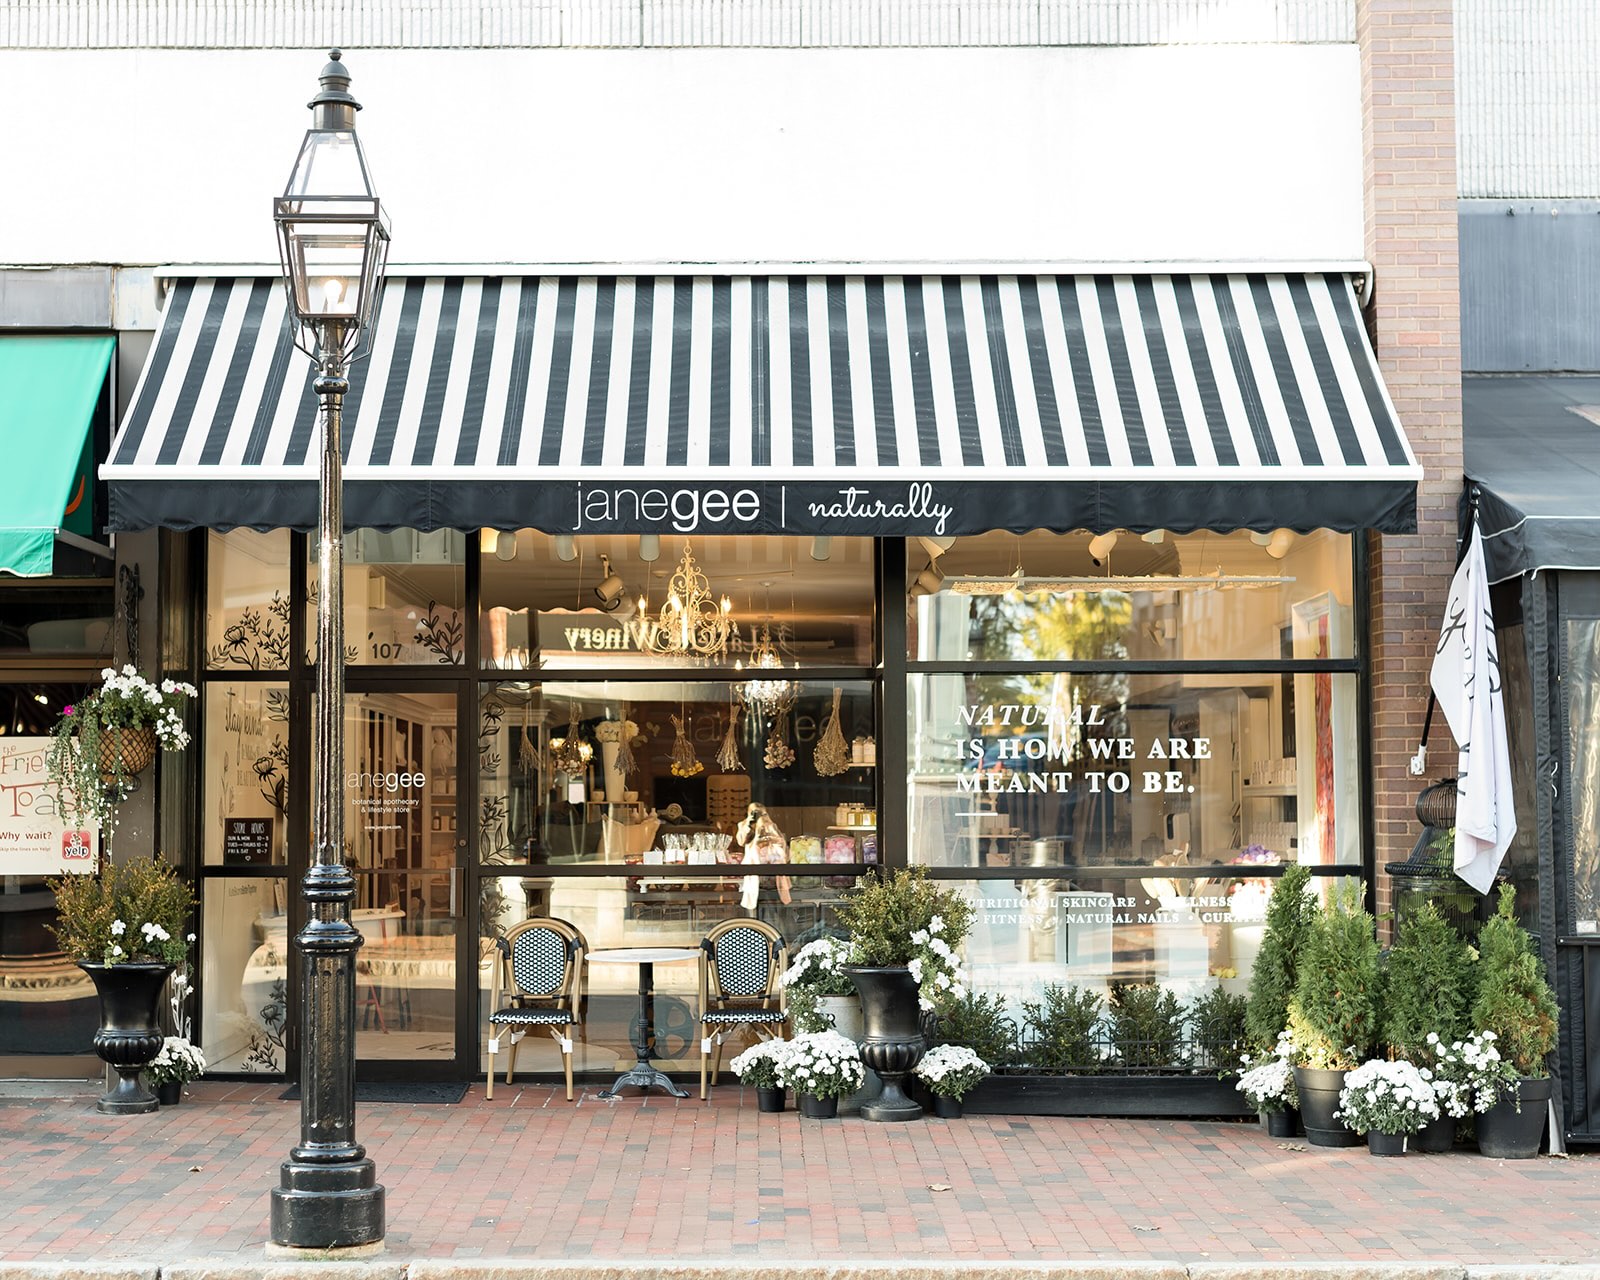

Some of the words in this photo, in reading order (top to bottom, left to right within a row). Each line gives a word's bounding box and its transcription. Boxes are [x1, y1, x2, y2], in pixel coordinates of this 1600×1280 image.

[573, 481, 760, 532] janegee
[808, 482, 953, 535] naturally
[372, 643, 402, 659] 107
[955, 705, 1106, 726] NATURAL
[956, 738, 985, 759] IS
[998, 738, 1076, 760] HOW
[1087, 738, 1136, 759] WE
[1147, 738, 1212, 759] ARE
[956, 772, 1073, 793] MEANT
[1085, 772, 1130, 793] TO
[1142, 771, 1195, 793] BE.
[0, 780, 91, 818] Toas
[368, 806, 392, 814] lifestyle
[25, 831, 52, 840] wait?
[66, 846, 89, 857] yelp
[1063, 898, 1136, 908] SKINCARE
[984, 914, 1042, 924] FITNESS
[1066, 914, 1133, 924] NATURAL
[1138, 914, 1179, 923] NAILS
